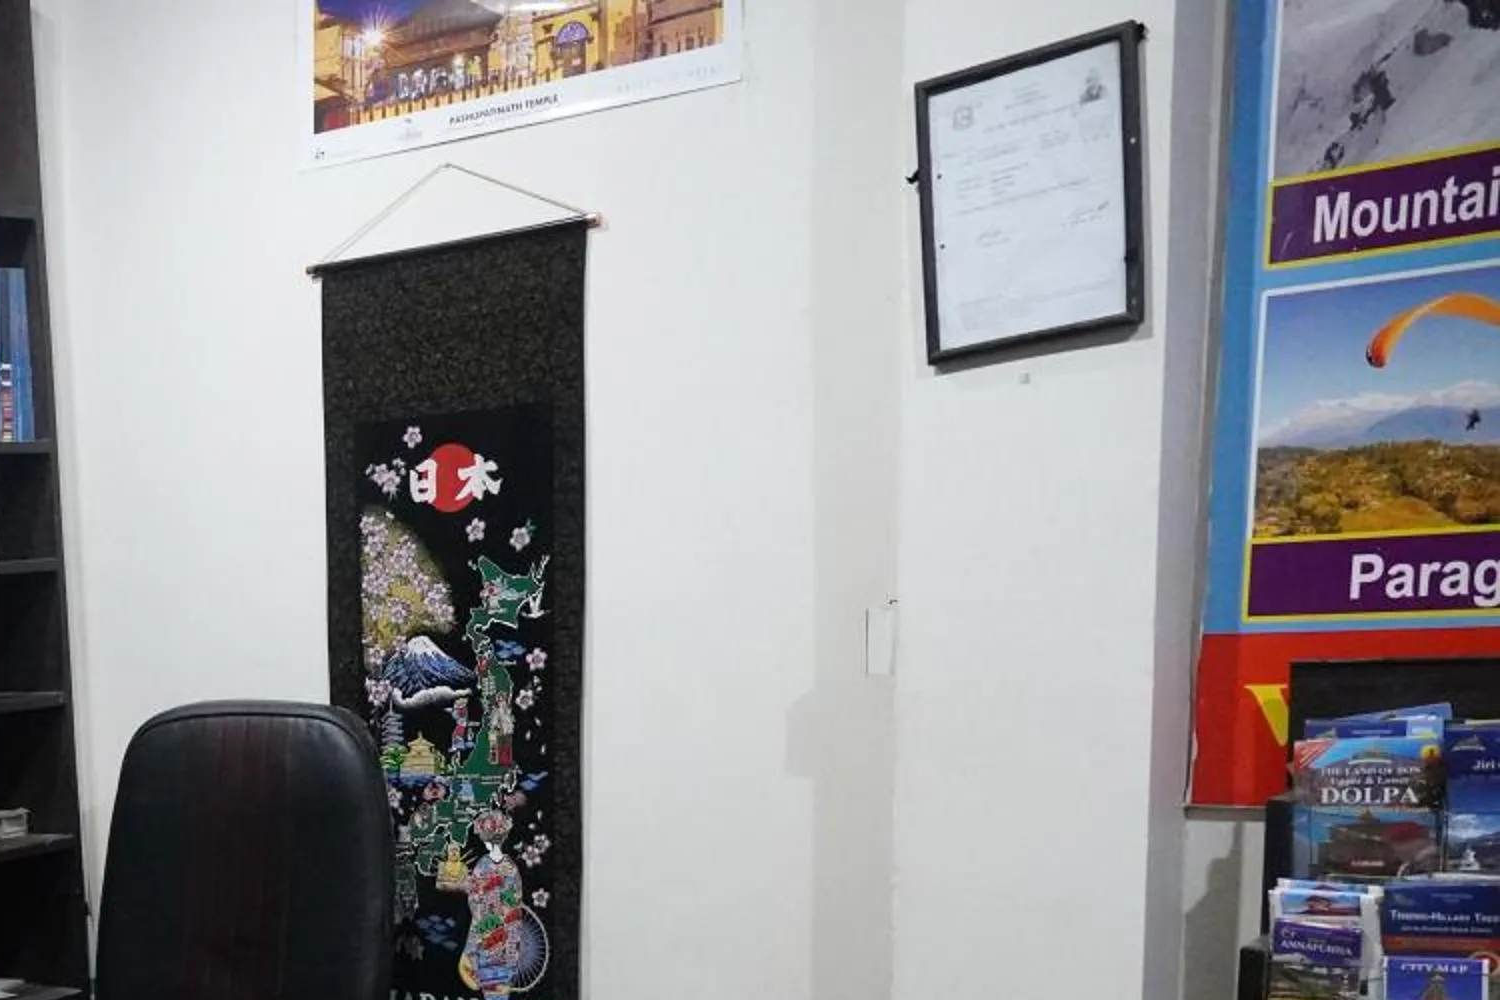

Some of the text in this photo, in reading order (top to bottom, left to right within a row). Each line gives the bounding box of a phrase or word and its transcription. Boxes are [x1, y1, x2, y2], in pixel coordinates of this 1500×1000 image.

[524, 93, 560, 111] TEMPLE
[1313, 165, 1500, 245] Mountai
[409, 452, 504, 504] 日本
[1348, 552, 1500, 612] Parag
[1320, 786, 1420, 805] DOLPA
[1400, 963, 1470, 974] CITY MAP
